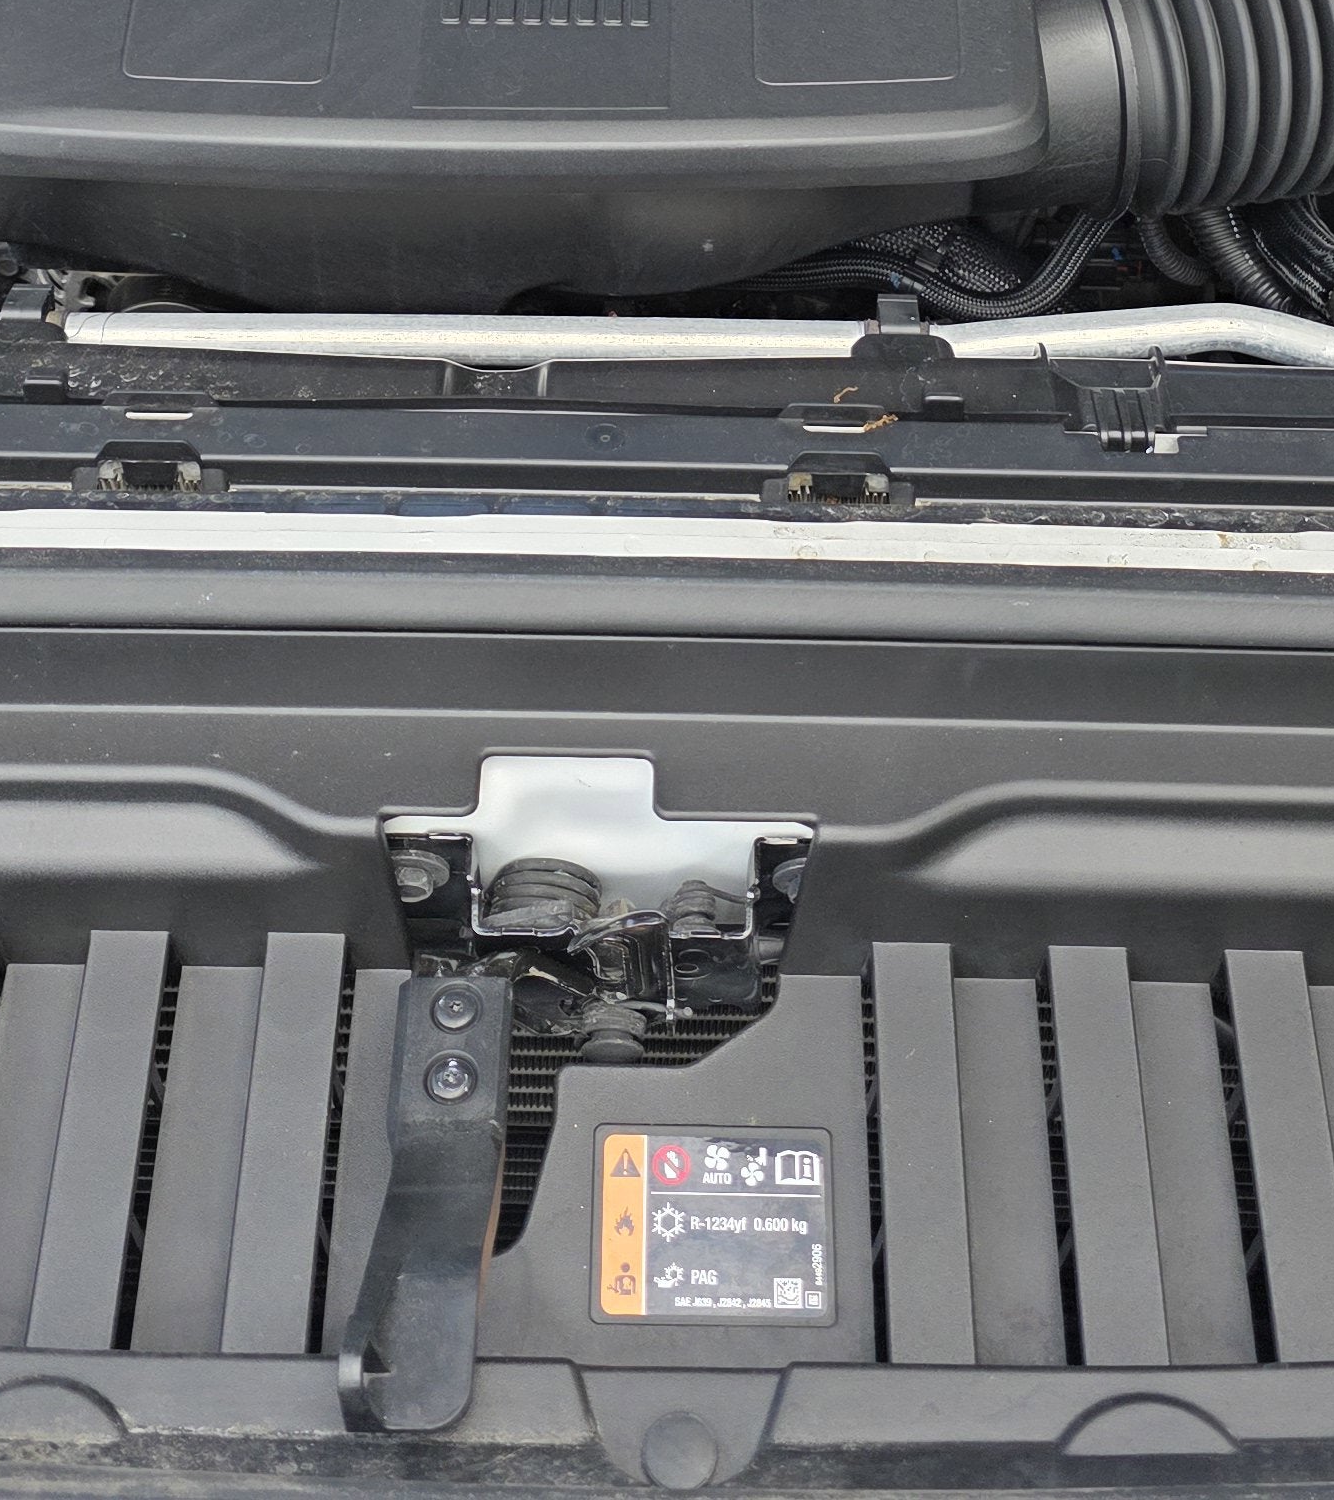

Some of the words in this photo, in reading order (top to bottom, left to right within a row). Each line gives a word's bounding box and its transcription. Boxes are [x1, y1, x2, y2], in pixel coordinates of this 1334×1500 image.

[703, 1172, 732, 1185] AUTO
[690, 1216, 746, 1233] R-1234yf
[754, 1217, 788, 1232] 0.600
[791, 1218, 808, 1235] kg
[691, 1270, 718, 1285] PAG
[674, 1296, 693, 1307] SAE
